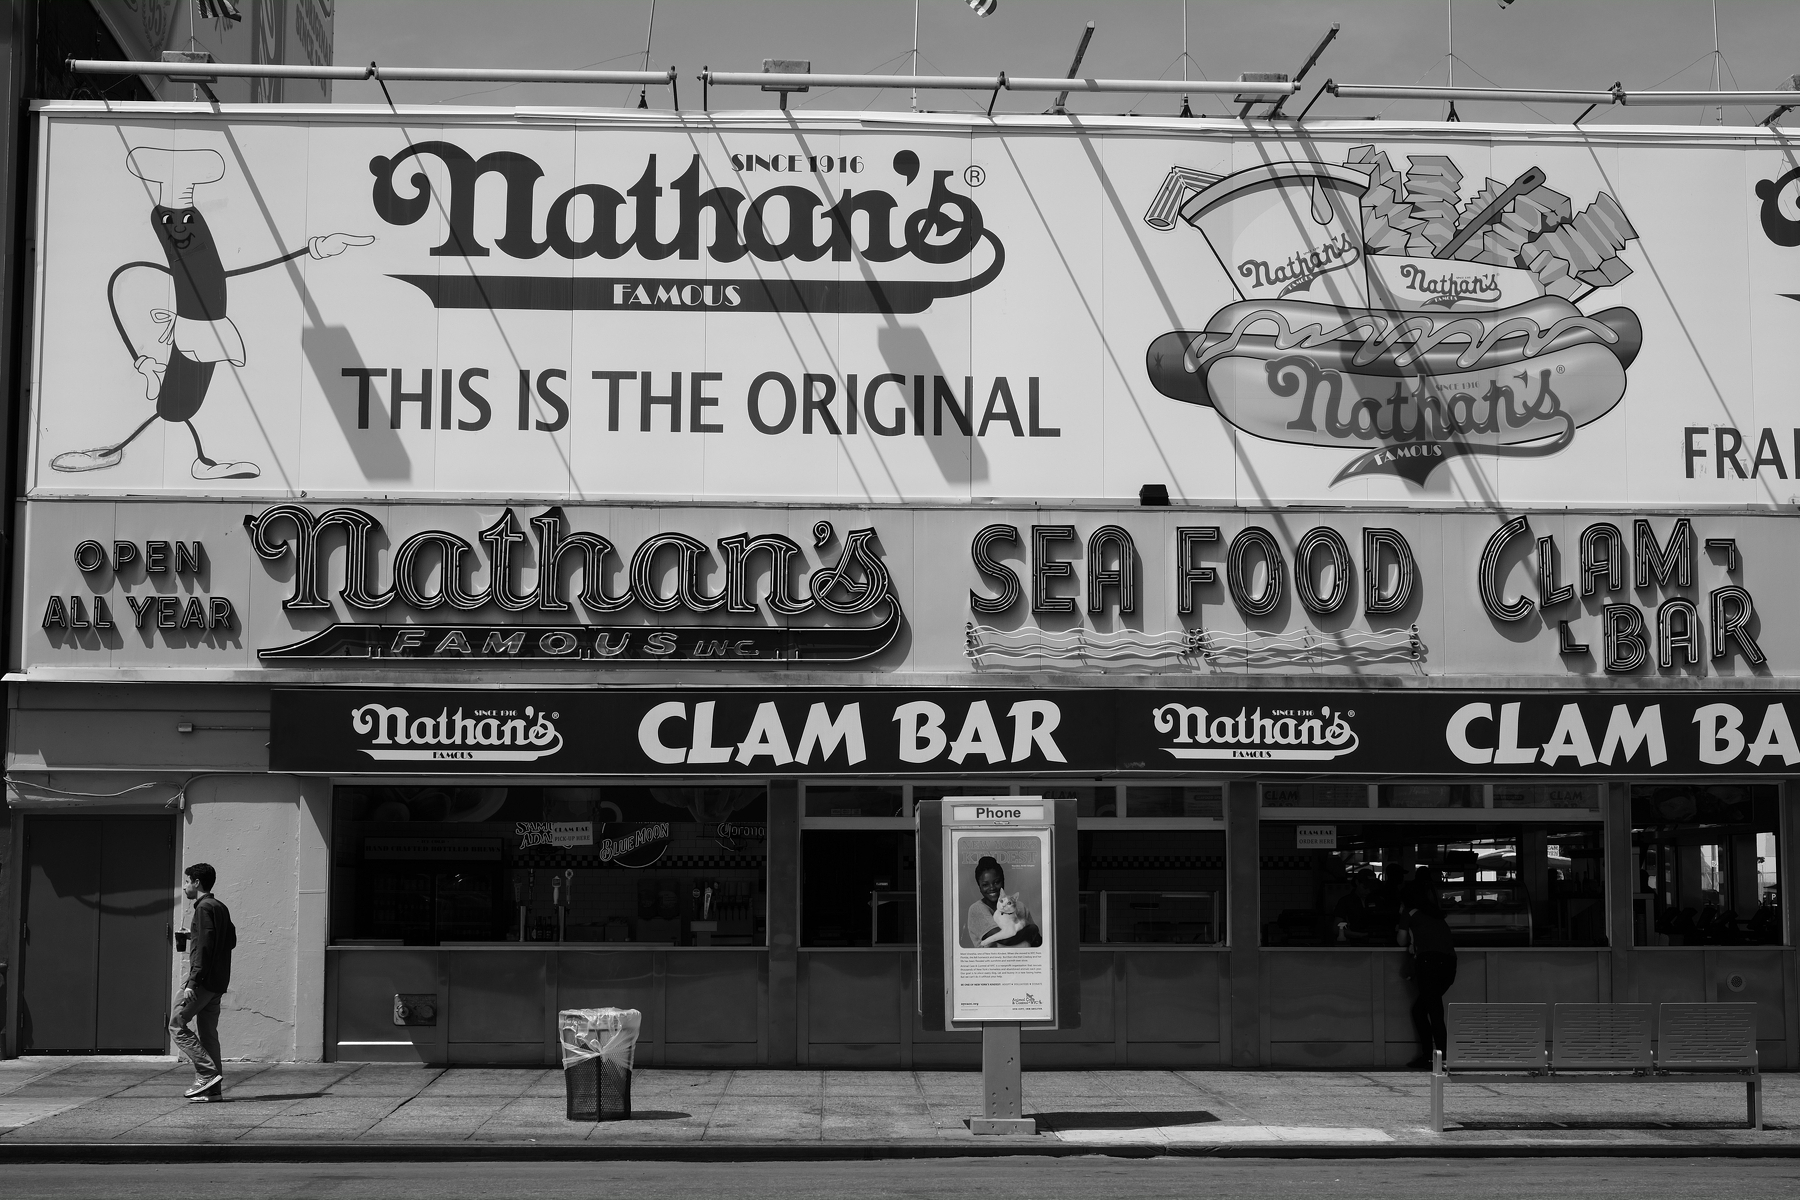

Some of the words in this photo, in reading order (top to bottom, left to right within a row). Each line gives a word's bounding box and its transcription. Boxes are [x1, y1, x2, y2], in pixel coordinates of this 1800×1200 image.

[731, 153, 802, 174] SINCE
[808, 155, 865, 175] 1916
[369, 140, 985, 264] Nathan's
[1237, 231, 1354, 291] Nathan's
[612, 283, 742, 307] FAMOUS
[1400, 263, 1498, 296] Nathan's
[341, 367, 492, 432] THIS
[518, 368, 570, 432] IS
[591, 370, 724, 434] THE
[746, 371, 1061, 437] ORIGINAL
[1265, 355, 1562, 443] Nathan's
[1435, 382, 1459, 392] SINCE
[1462, 381, 1481, 390] 1916
[1373, 443, 1443, 466] FAMOUS
[1684, 426, 1800, 480] FRA
[74, 539, 202, 573] OPEN
[242, 503, 890, 616] Nathan's
[969, 523, 1136, 617] SEA
[1179, 524, 1416, 617] FOOD
[1478, 515, 1692, 623] CLAM
[42, 595, 114, 629] ALL
[126, 596, 234, 630] YEAR
[1603, 585, 1768, 673] BAR
[390, 630, 679, 656] FAMOUS
[351, 703, 556, 747] Nathan's
[474, 709, 498, 717] SINCE
[500, 709, 518, 717] 1916
[1152, 702, 1352, 746] Nathan's
[1272, 709, 1296, 717] SINCE
[1297, 709, 1315, 717] 1916
[637, 700, 868, 767] CLAM
[891, 699, 1069, 766] BAR
[1445, 701, 1669, 768] CLAM
[432, 751, 474, 760] FAMOUS
[1232, 750, 1272, 759] FAMOUS
[1264, 790, 1298, 801] CLAM
[1549, 790, 1583, 801] CLAM
[976, 807, 1022, 819] Phone
[519, 832, 553, 850] ADA
[600, 835, 635, 862] BLUE
[634, 822, 670, 848] MOON
[961, 839, 991, 850] NEW
[995, 839, 1039, 850] YORK'S
